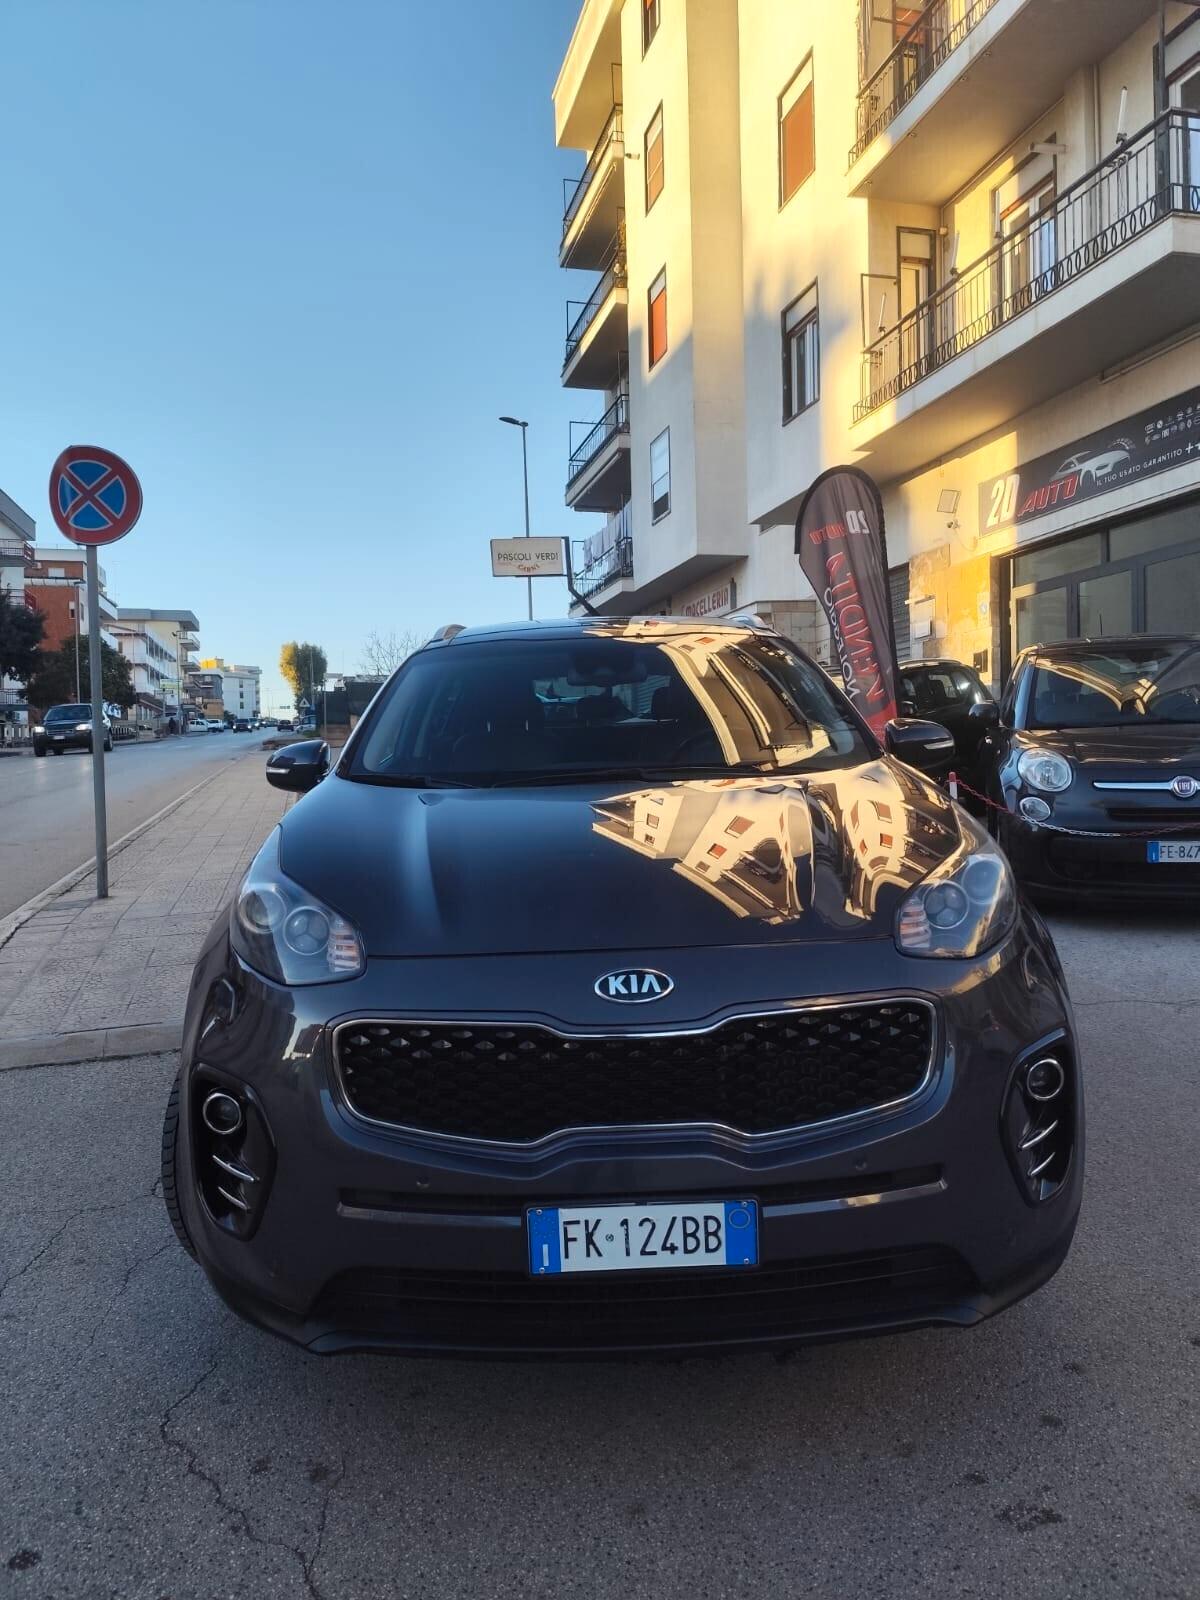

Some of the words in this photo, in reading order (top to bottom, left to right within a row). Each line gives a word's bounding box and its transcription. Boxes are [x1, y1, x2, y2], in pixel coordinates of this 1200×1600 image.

[1104, 474, 1118, 484] TUO
[1120, 464, 1141, 478] USATO
[1143, 448, 1183, 468] GARANTITO
[1017, 472, 1079, 518] AUTO
[497, 552, 532, 562] PASCOLI
[535, 552, 560, 561] VERDI
[607, 974, 662, 995] KIA
